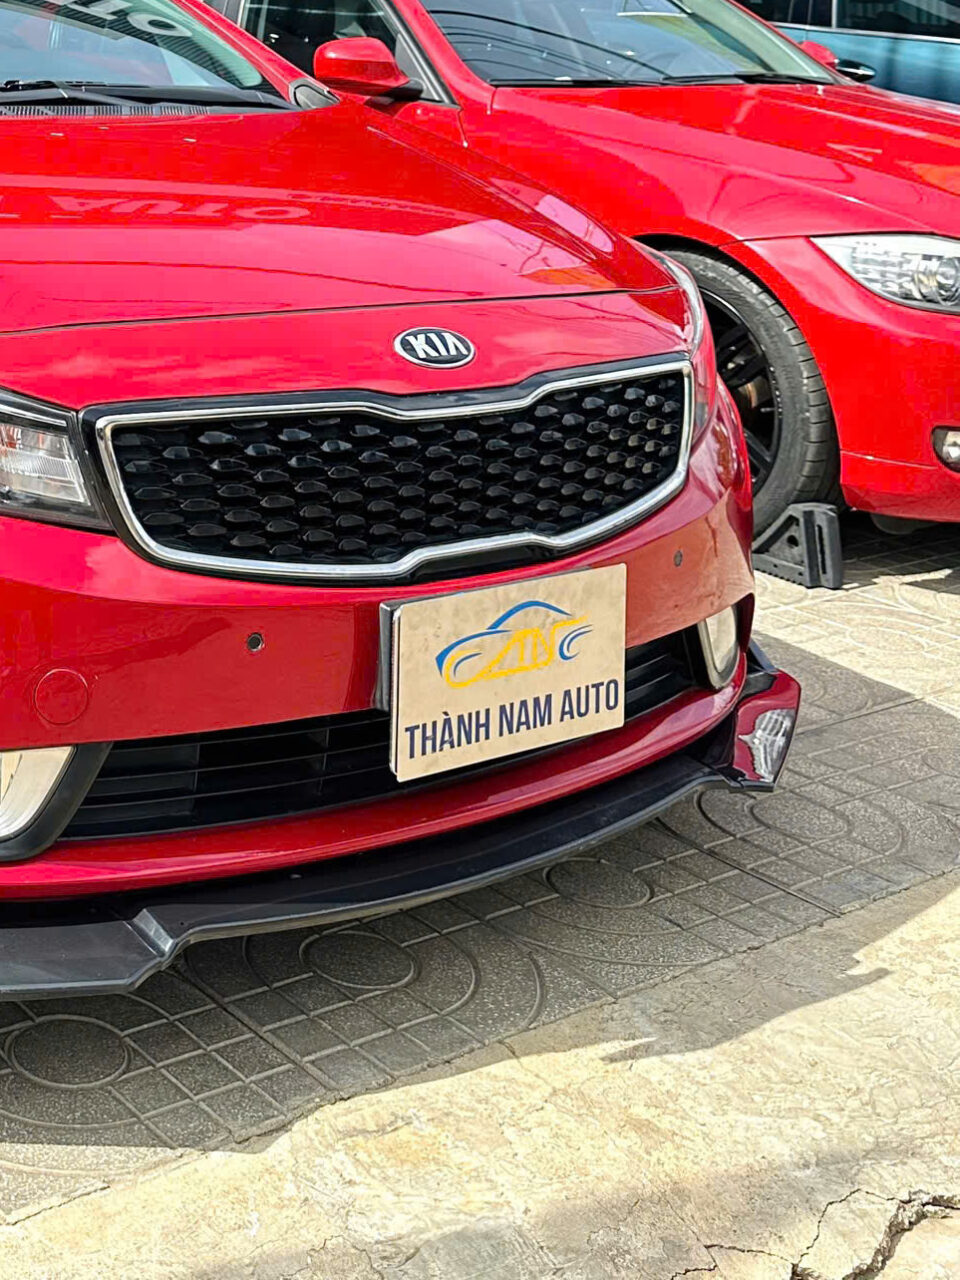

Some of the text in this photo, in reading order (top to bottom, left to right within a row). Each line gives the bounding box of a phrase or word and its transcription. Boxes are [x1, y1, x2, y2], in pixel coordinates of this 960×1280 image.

[405, 333, 468, 359] KIA
[405, 679, 619, 759] THÀNH NAM AUTO
